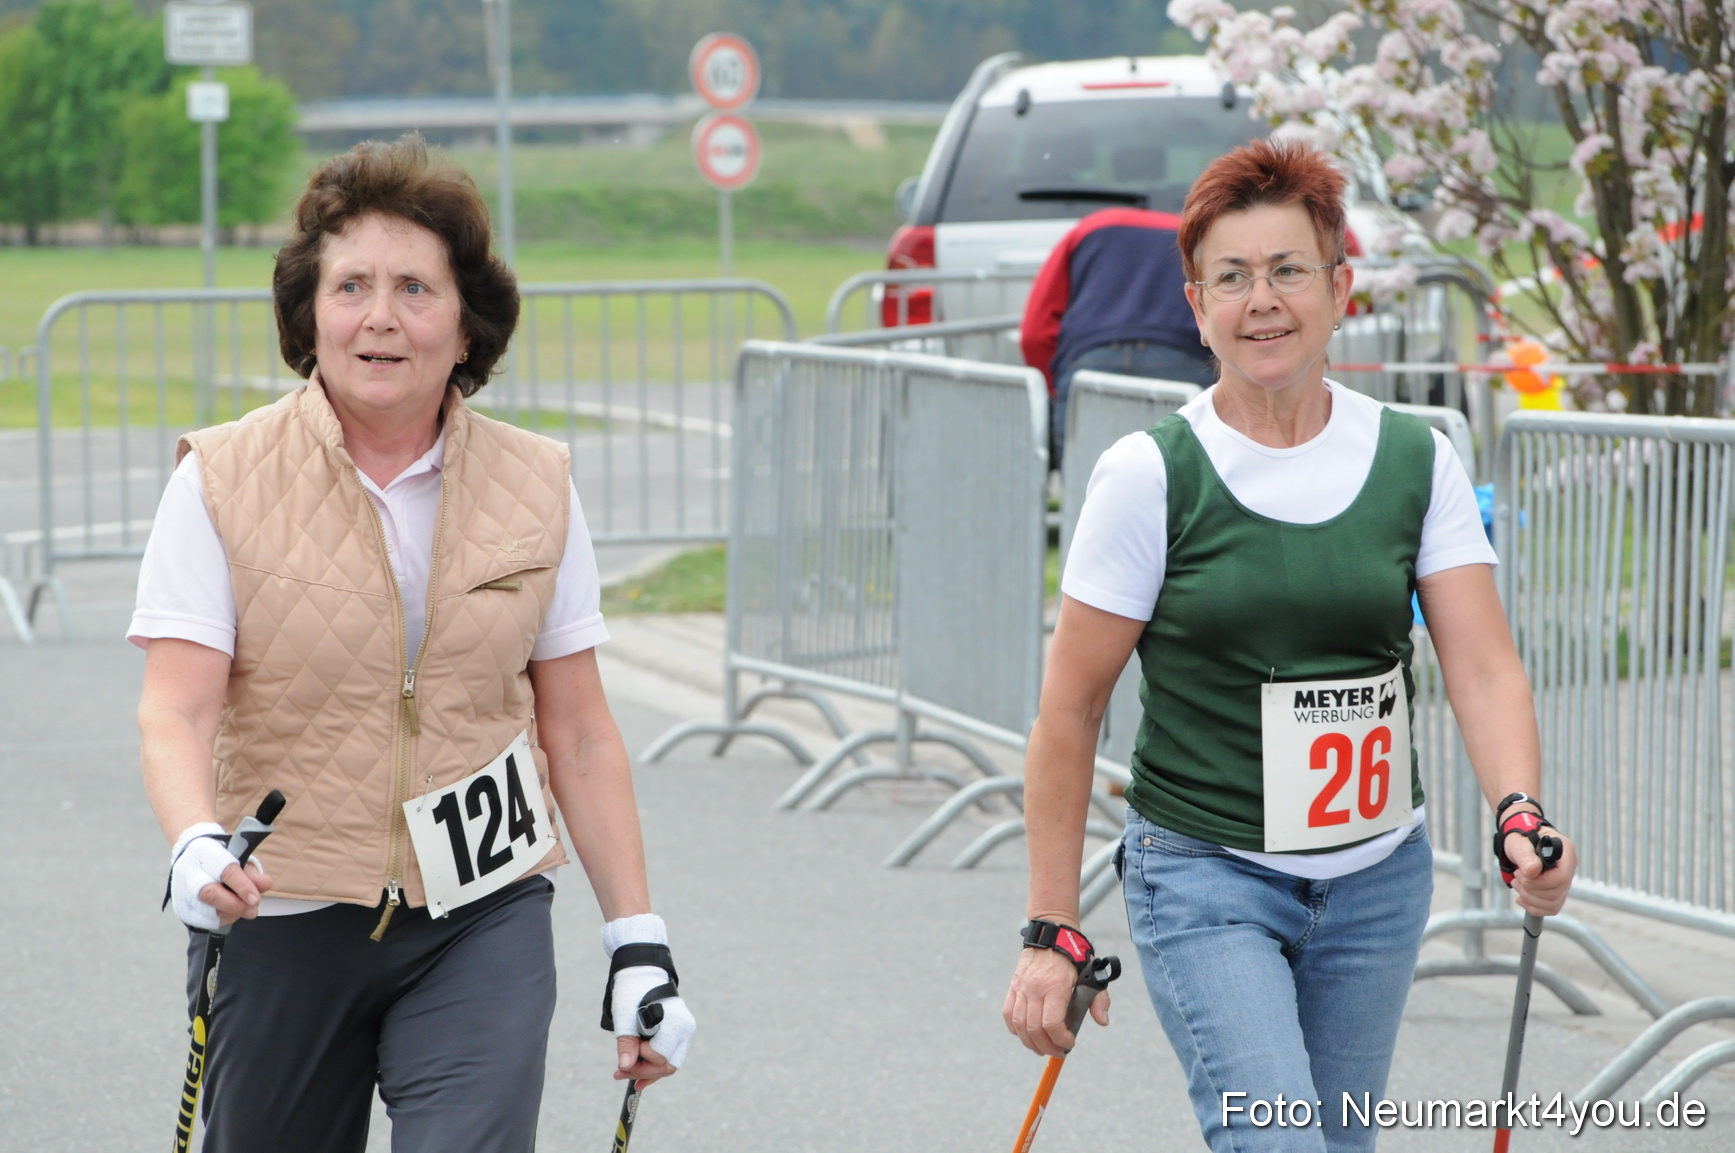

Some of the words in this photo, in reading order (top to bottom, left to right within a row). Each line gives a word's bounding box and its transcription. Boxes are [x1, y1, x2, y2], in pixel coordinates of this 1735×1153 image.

[1294, 686, 1374, 708] MEYER
[1294, 706, 1374, 723] WERBUNG
[1308, 725, 1392, 828] 26
[432, 752, 537, 887] 124
